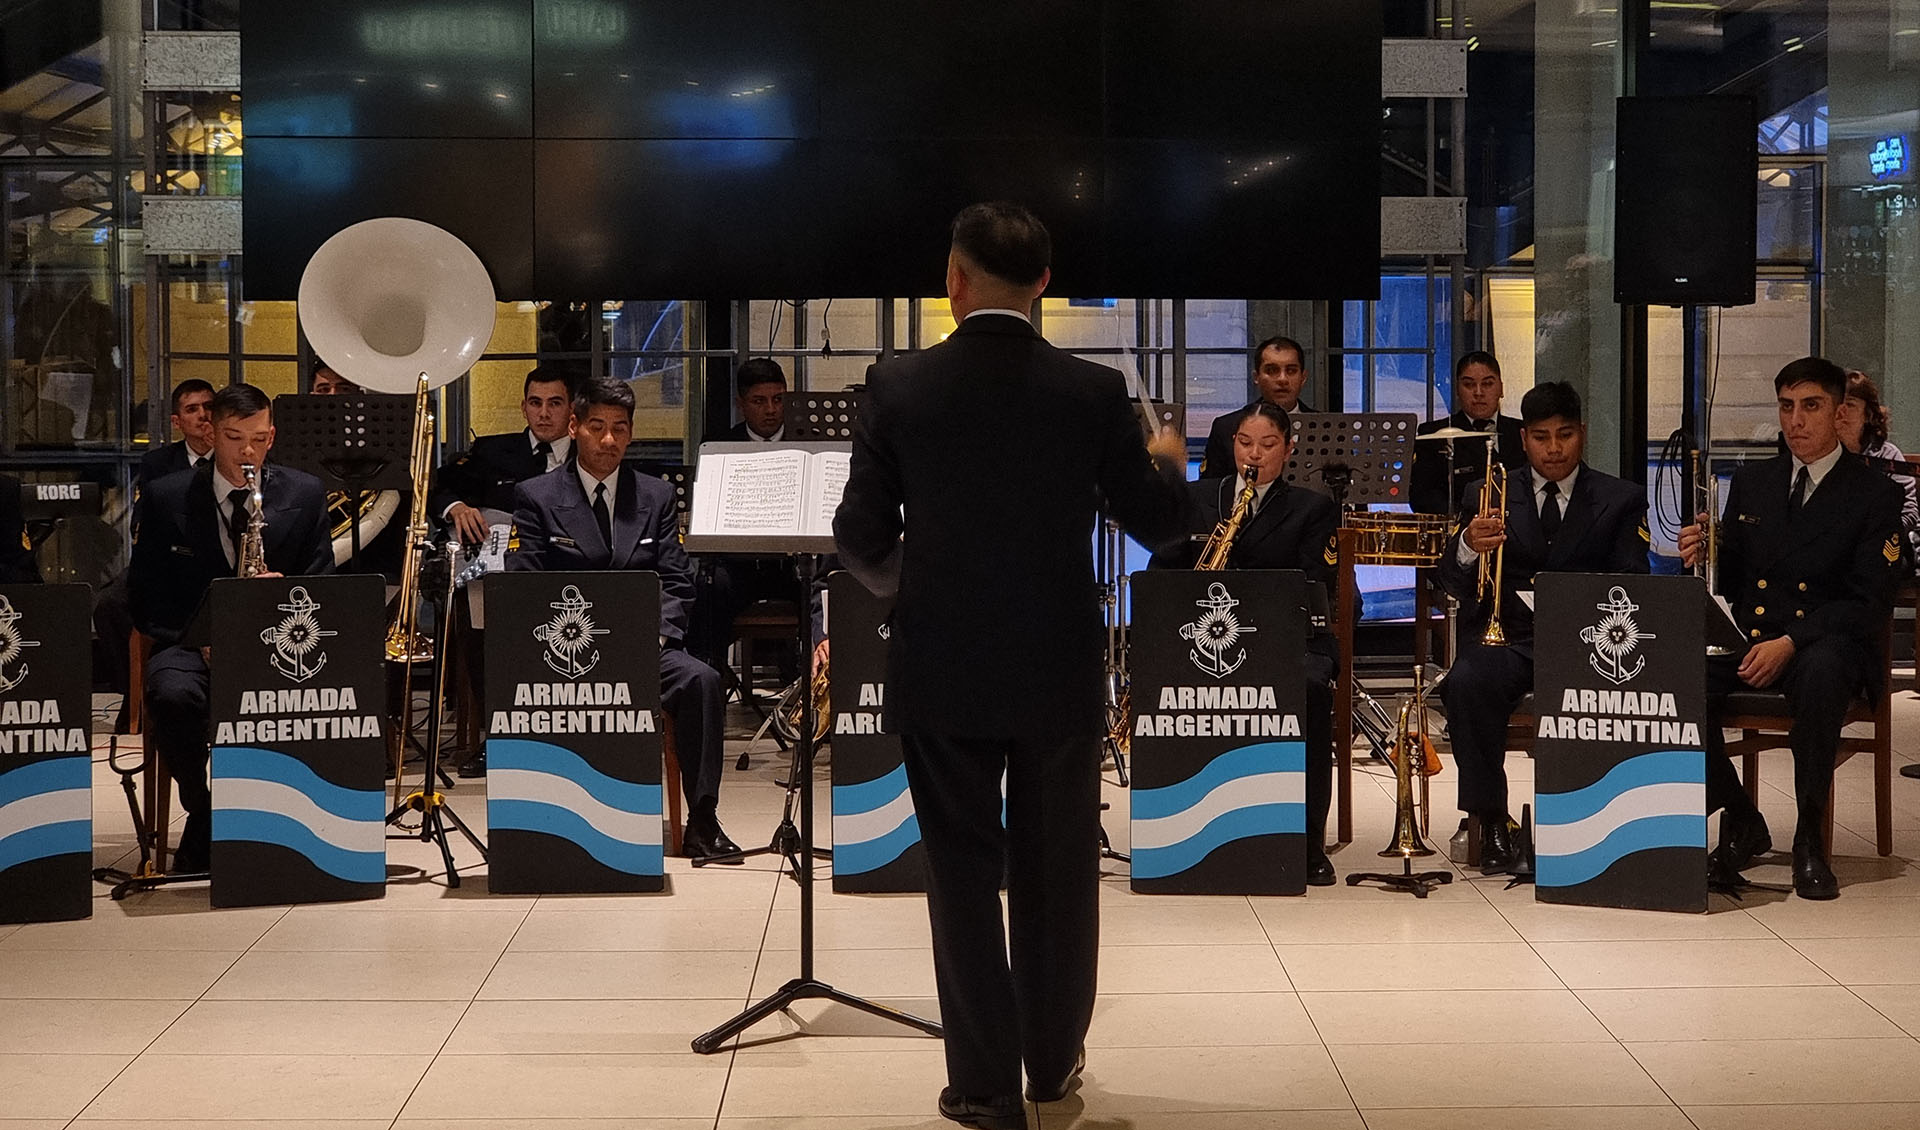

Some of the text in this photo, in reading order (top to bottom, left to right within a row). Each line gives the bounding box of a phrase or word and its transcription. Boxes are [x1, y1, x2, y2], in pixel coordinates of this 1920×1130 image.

[36, 484, 81, 501] KORG
[239, 687, 357, 714] ARMADA
[514, 682, 632, 706] ARMADA
[1158, 686, 1277, 710] ARMADA
[1561, 688, 1678, 717] ARMADA
[215, 715, 381, 744] ARGENTINA
[490, 710, 656, 734] ARGENTINA
[1134, 714, 1301, 737] ARGENTINA
[1537, 715, 1701, 746] ARGENTINA
